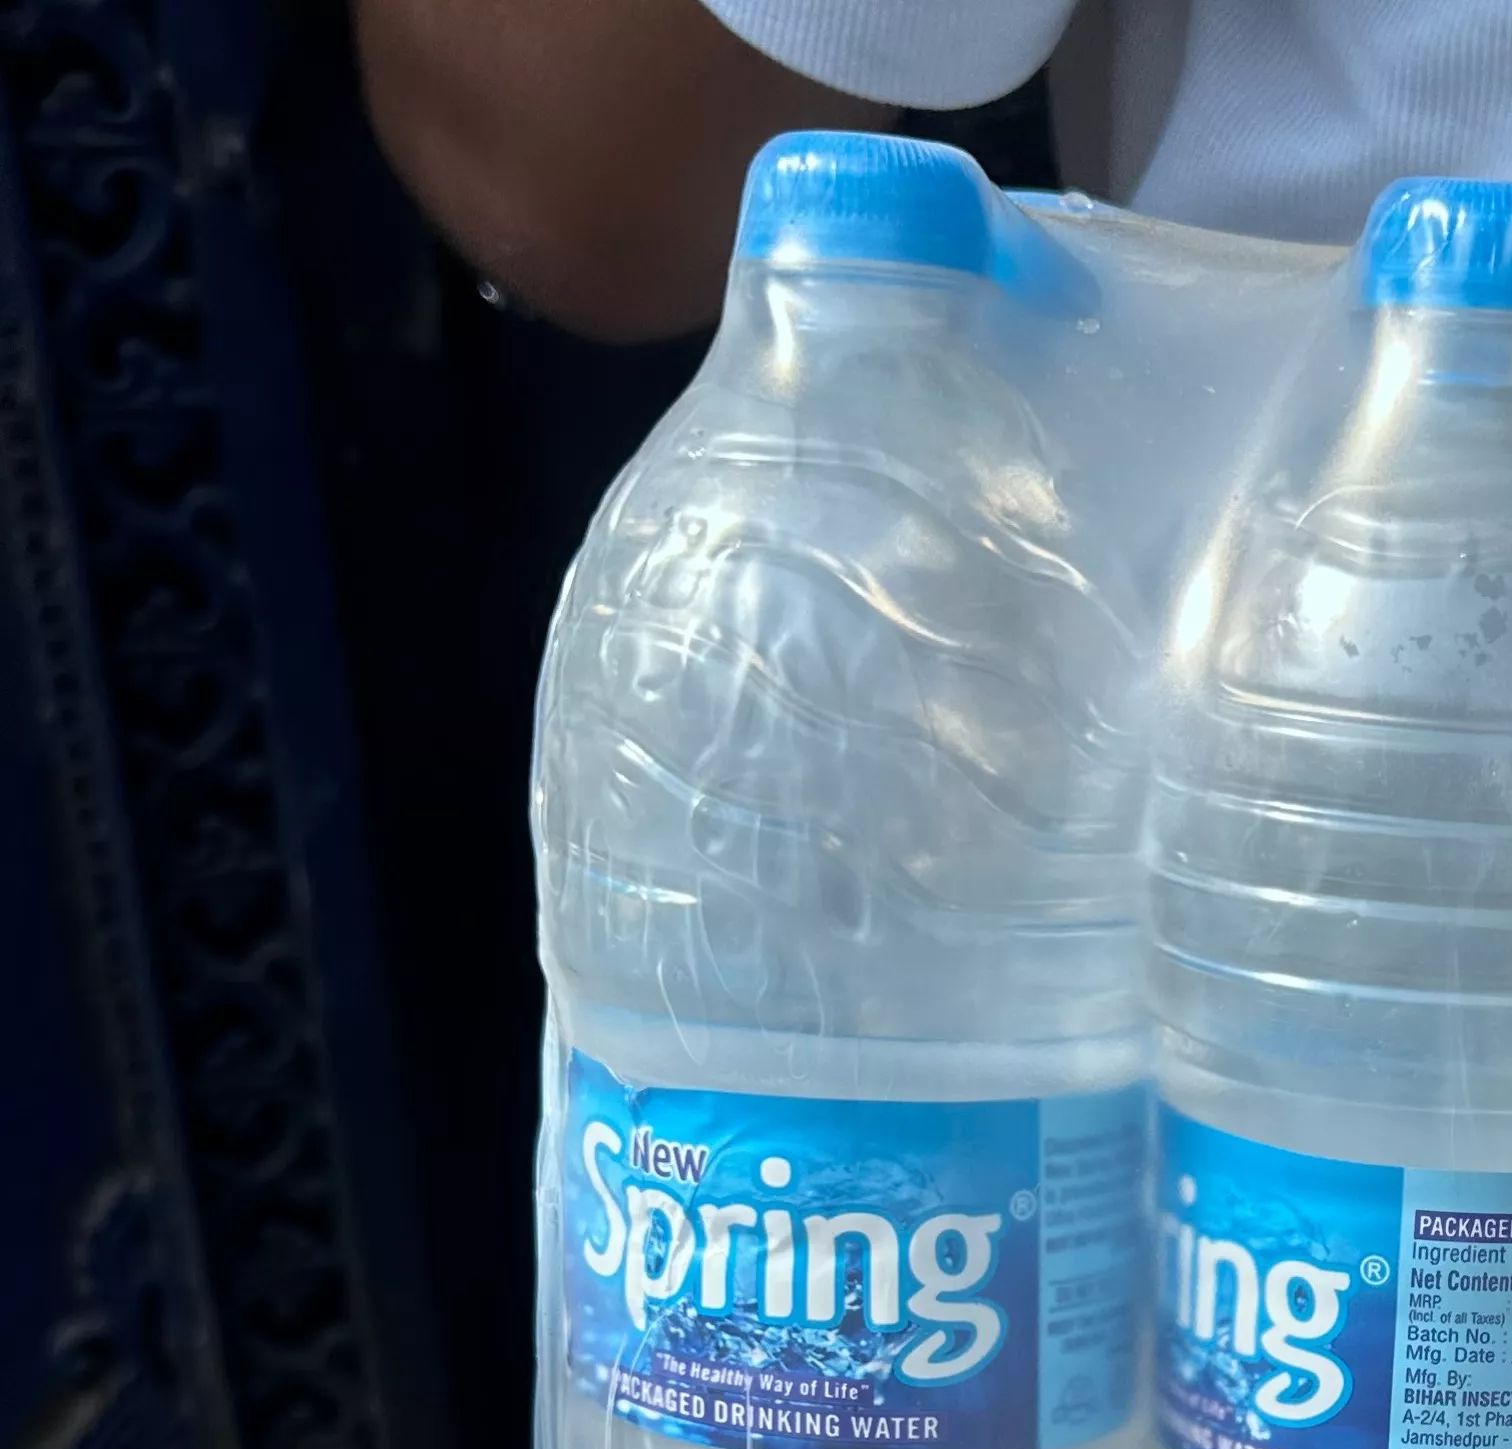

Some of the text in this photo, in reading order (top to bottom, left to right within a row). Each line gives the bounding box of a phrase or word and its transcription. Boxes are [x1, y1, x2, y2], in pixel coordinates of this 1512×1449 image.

[632, 1127, 708, 1183] New
[582, 1121, 1001, 1380] Spring
[1412, 1242, 1505, 1265] Ingredient
[1410, 1268, 1442, 1290] Net
[1160, 1175, 1351, 1423] ing
[1440, 1311, 1453, 1324] of
[1454, 1312, 1467, 1324] all
[1470, 1312, 1505, 1326] Taxes)
[1407, 1325, 1458, 1344] Batch
[1466, 1329, 1496, 1345] No.
[1406, 1345, 1447, 1364] Mfg.
[1454, 1347, 1495, 1363] Date
[690, 1359, 753, 1389] Healthy
[759, 1373, 793, 1398] Way
[800, 1380, 817, 1398] of
[1406, 1367, 1472, 1390] Mfg. By:
[1404, 1388, 1456, 1406] BIHAR
[714, 1400, 840, 1437] DRINKING
[851, 1416, 939, 1439] WATER
[1402, 1409, 1450, 1428] A-2/4,
[1457, 1411, 1481, 1427] 1st
[1401, 1429, 1499, 1449] Jamshedpur
